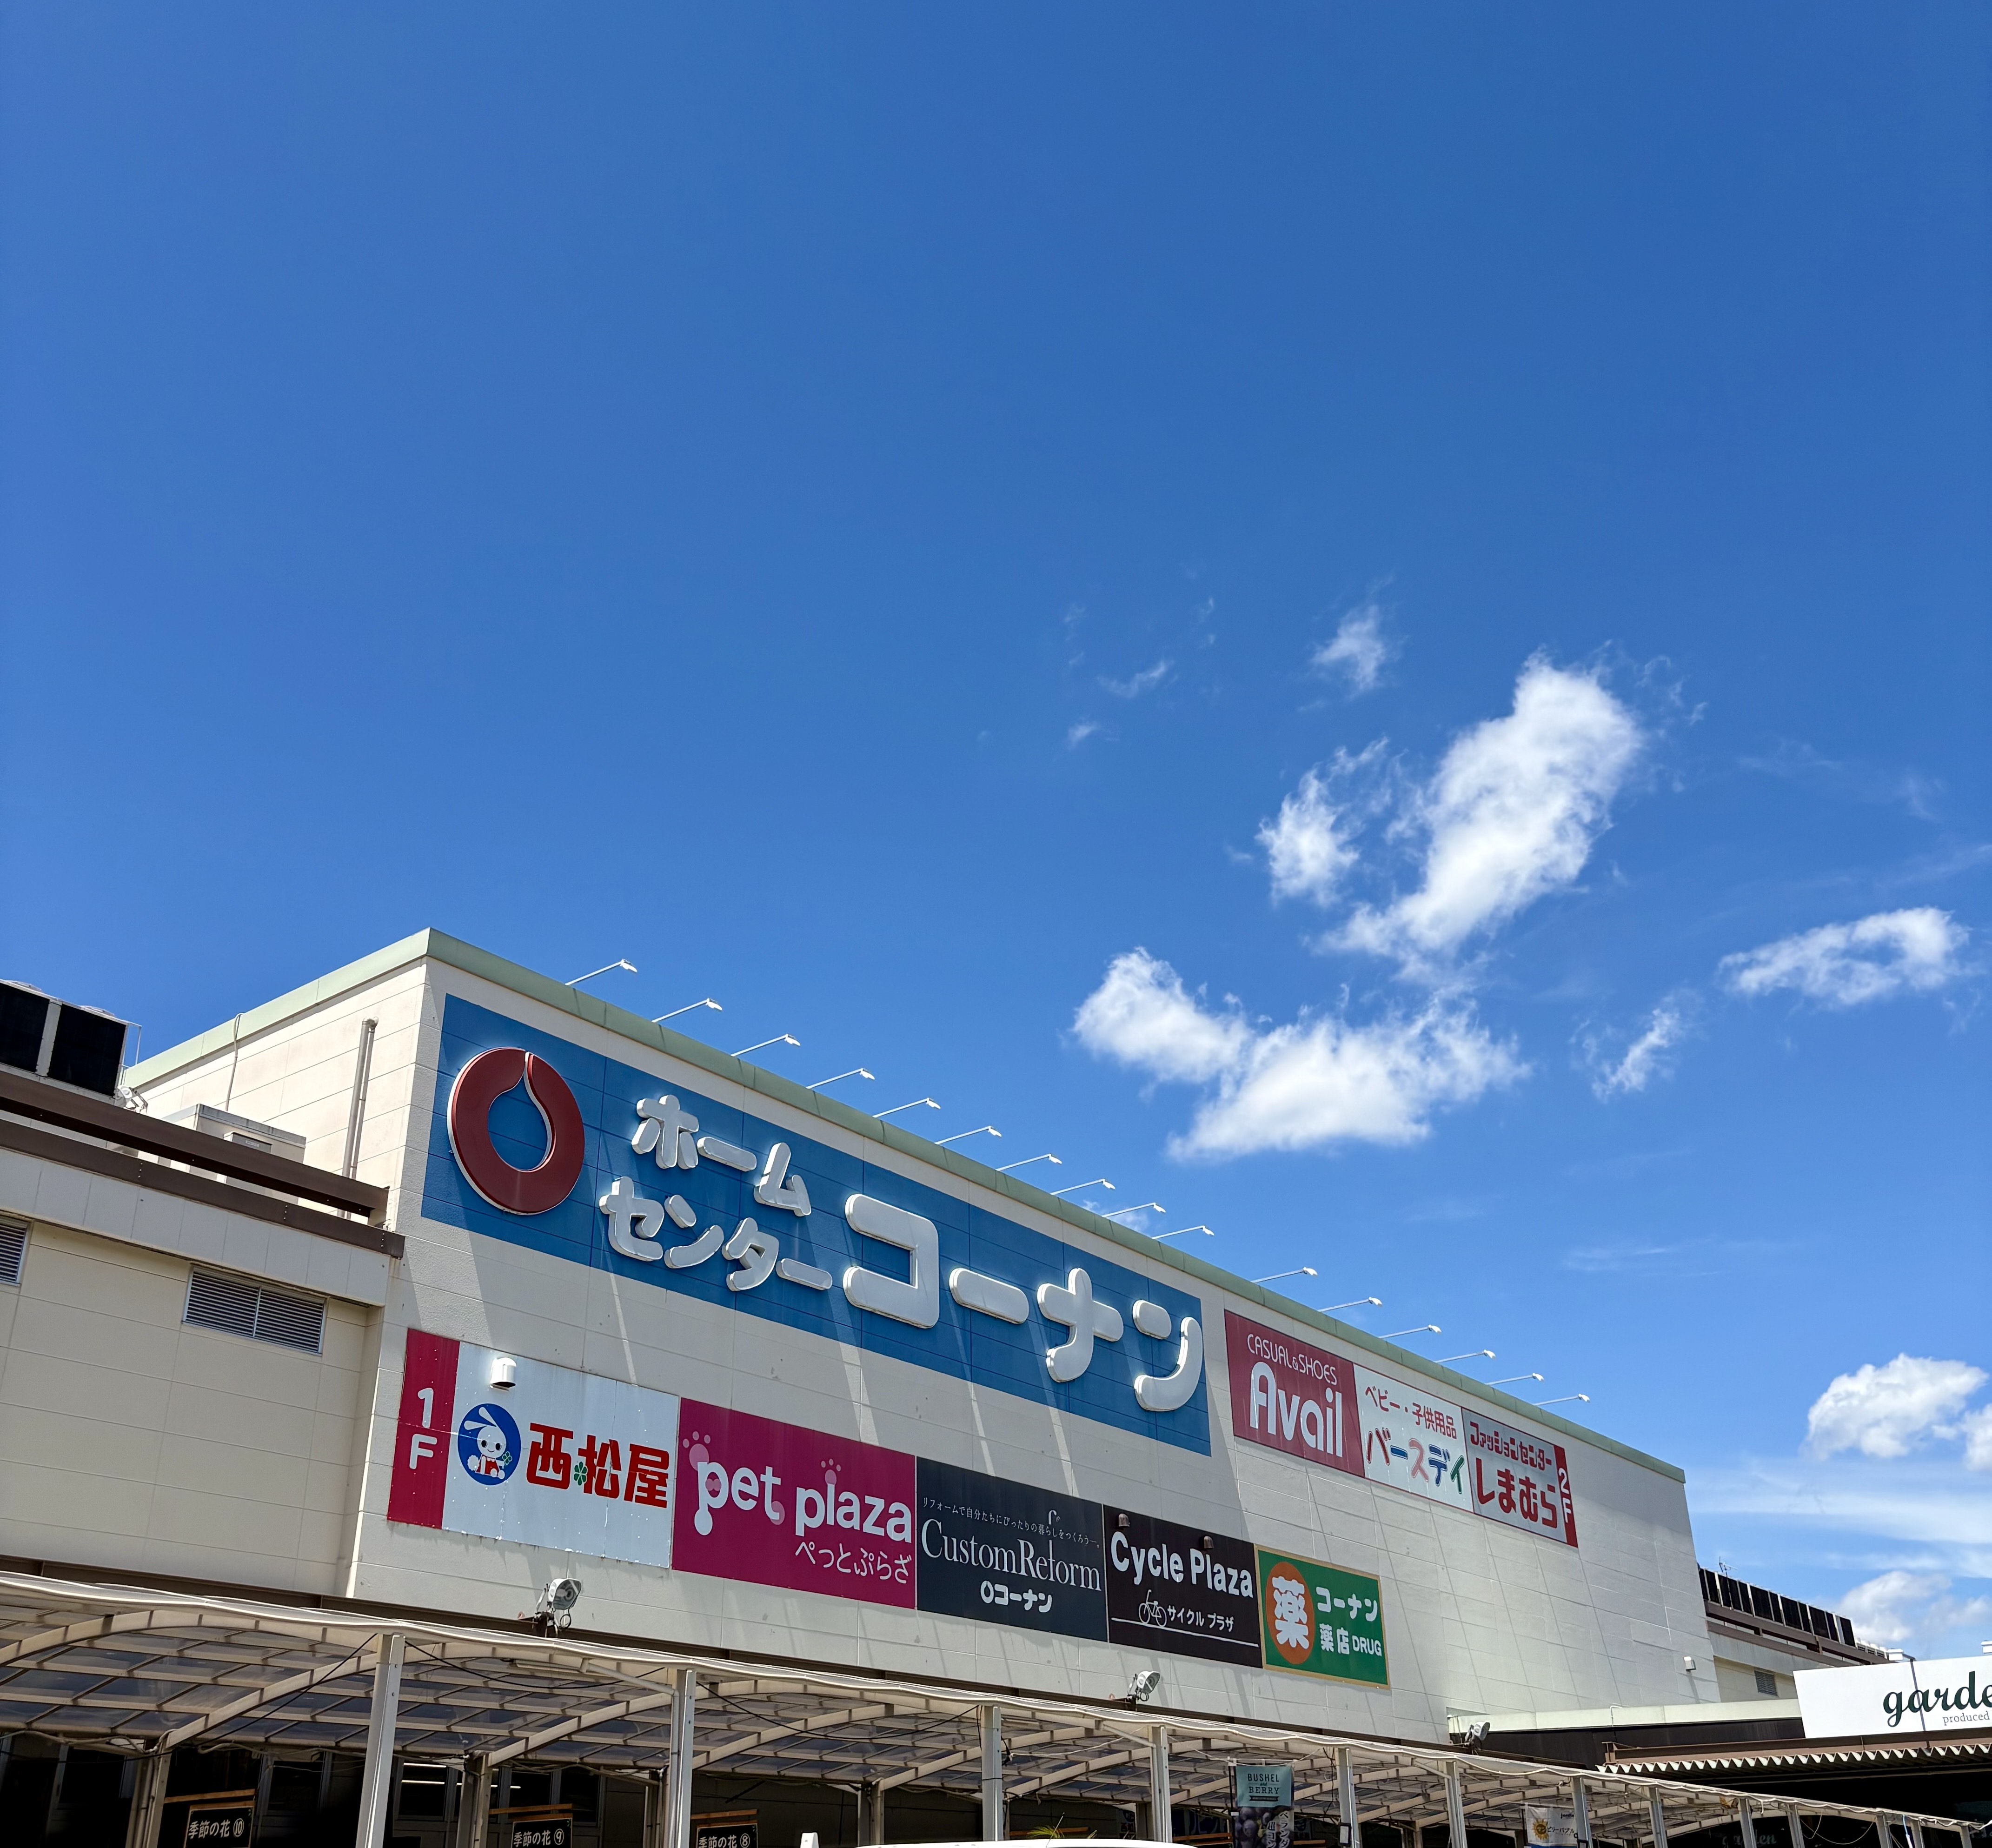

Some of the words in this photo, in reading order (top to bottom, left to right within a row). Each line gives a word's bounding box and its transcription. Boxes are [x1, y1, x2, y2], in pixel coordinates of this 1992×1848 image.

[632, 1095, 811, 1216] ホーム
[599, 1176, 833, 1292] センター
[843, 1193, 1203, 1412] コーナン
[1249, 1362, 1342, 1458] Avail
[526, 1422, 670, 1509] 西松屋
[1470, 1421, 1552, 1471] ファッションセンター
[694, 1461, 781, 1535] pet
[795, 1483, 912, 1543] plaza
[1475, 1457, 1558, 1529] しまむら
[1558, 1468, 1572, 1523] 2F
[795, 1541, 912, 1584] ぺっとぷらざ
[1111, 1531, 1184, 1585] Cycle
[1190, 1548, 1254, 1599] Plaza
[1272, 1575, 1309, 1649] 薬
[1315, 1586, 1378, 1622] コーナン
[1352, 1635, 1382, 1657] DRUG
[1943, 1711, 1990, 1726] produced
[1248, 1773, 1279, 1782] BUSHEL
